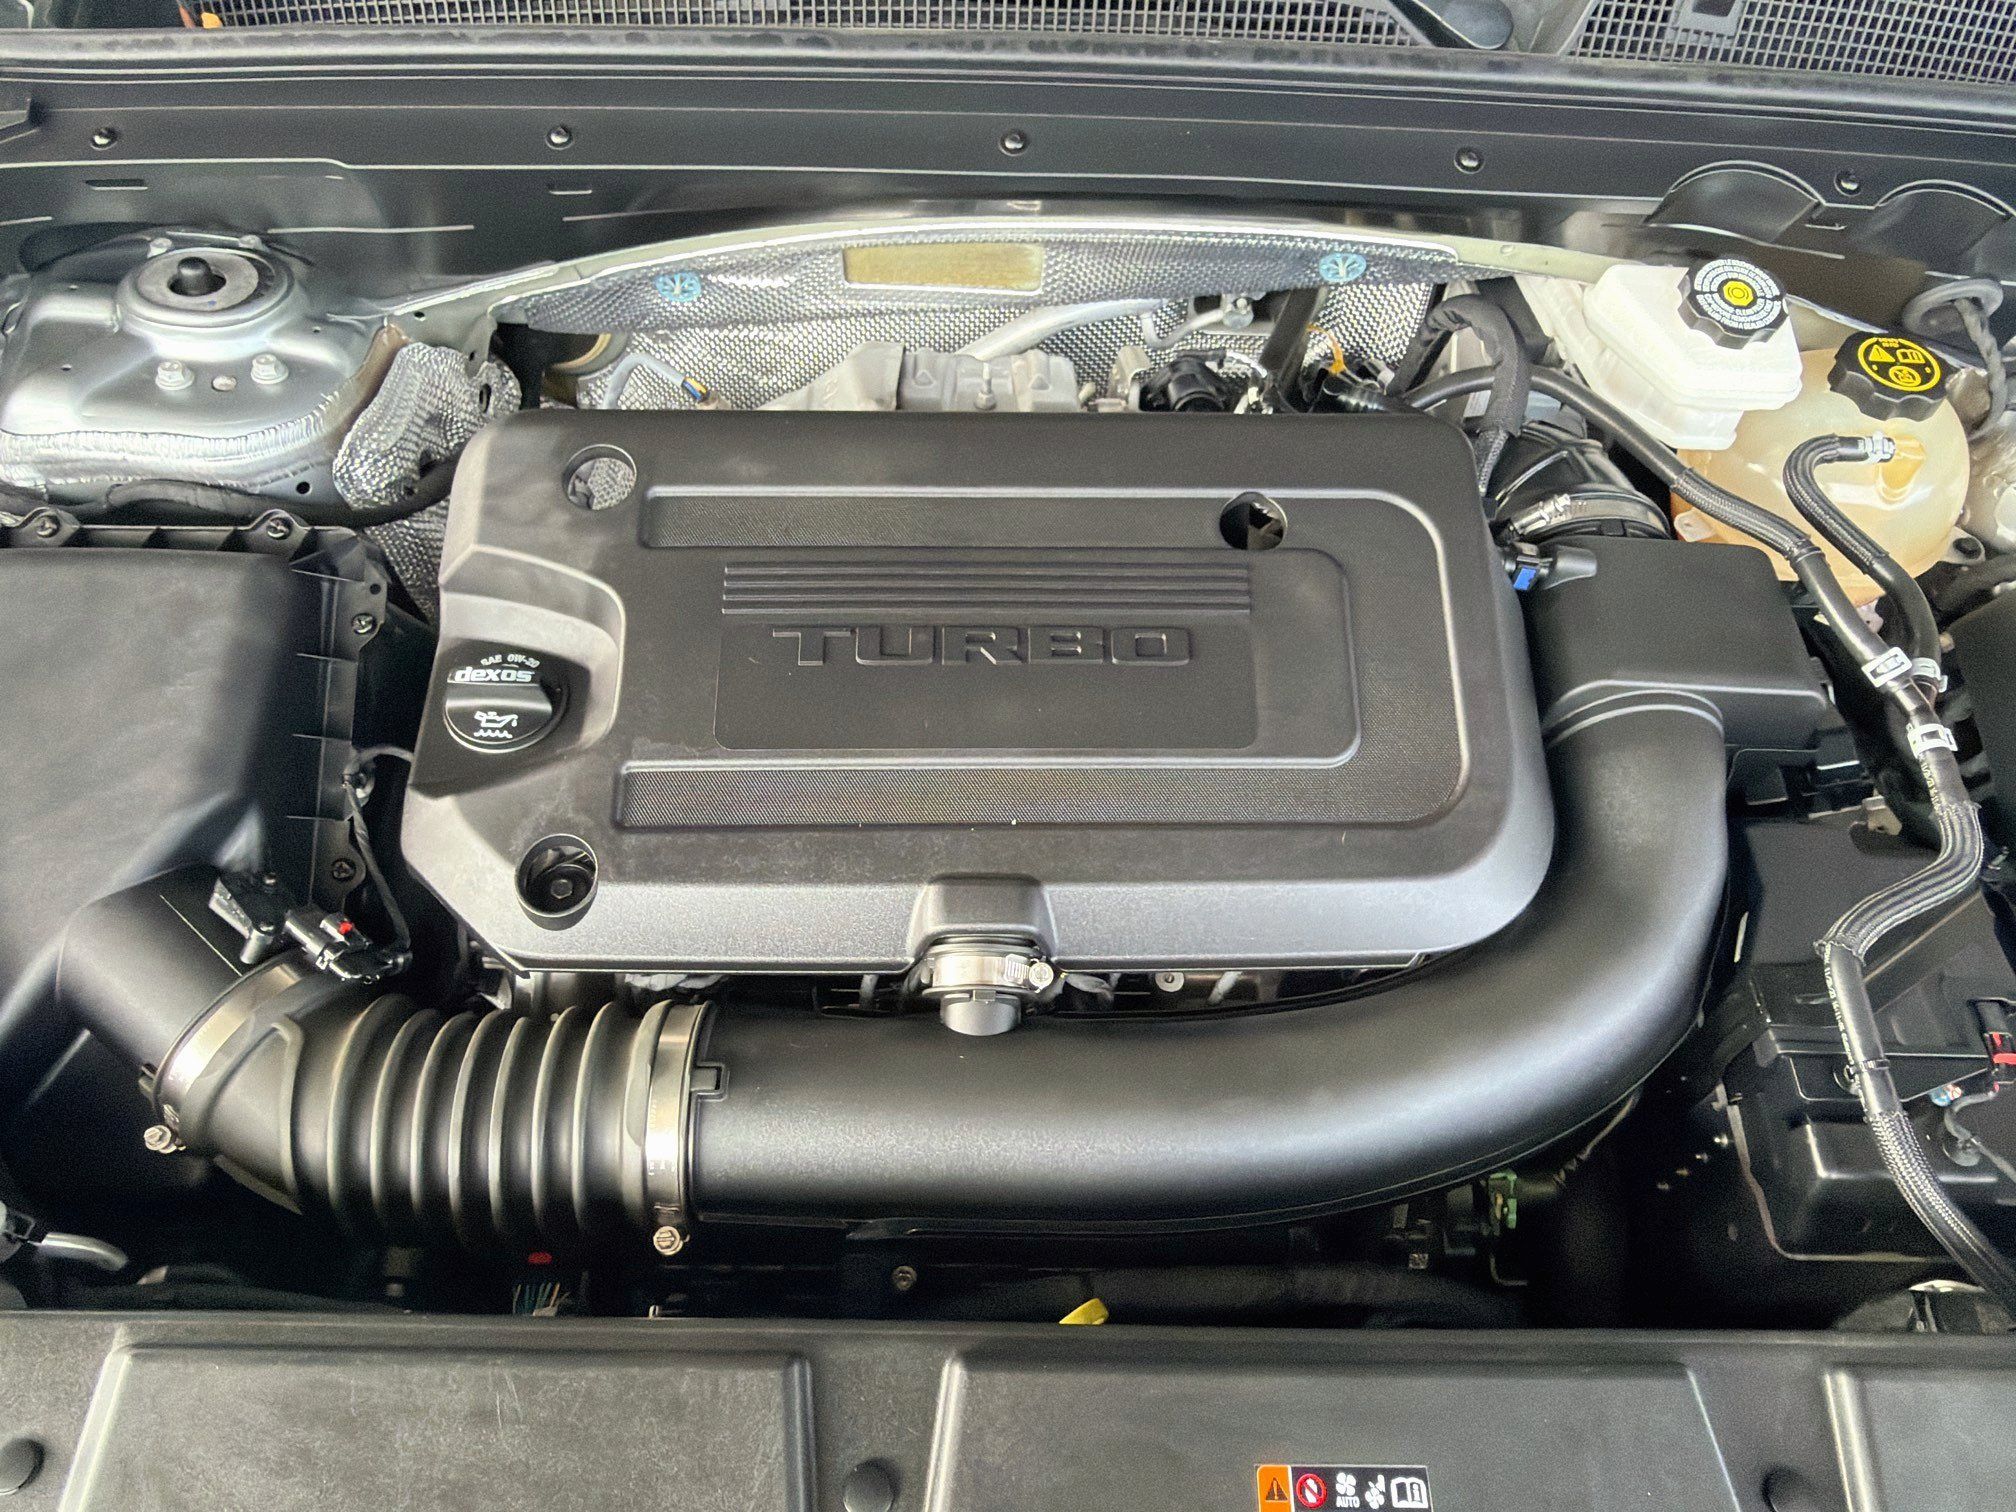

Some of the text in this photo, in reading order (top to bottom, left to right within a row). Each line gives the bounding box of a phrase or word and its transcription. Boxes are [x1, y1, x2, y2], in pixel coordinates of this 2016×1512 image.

[772, 625, 1194, 666] TURBO
[454, 666, 535, 682] dexos
[1336, 1496, 1360, 1508] AUTO
